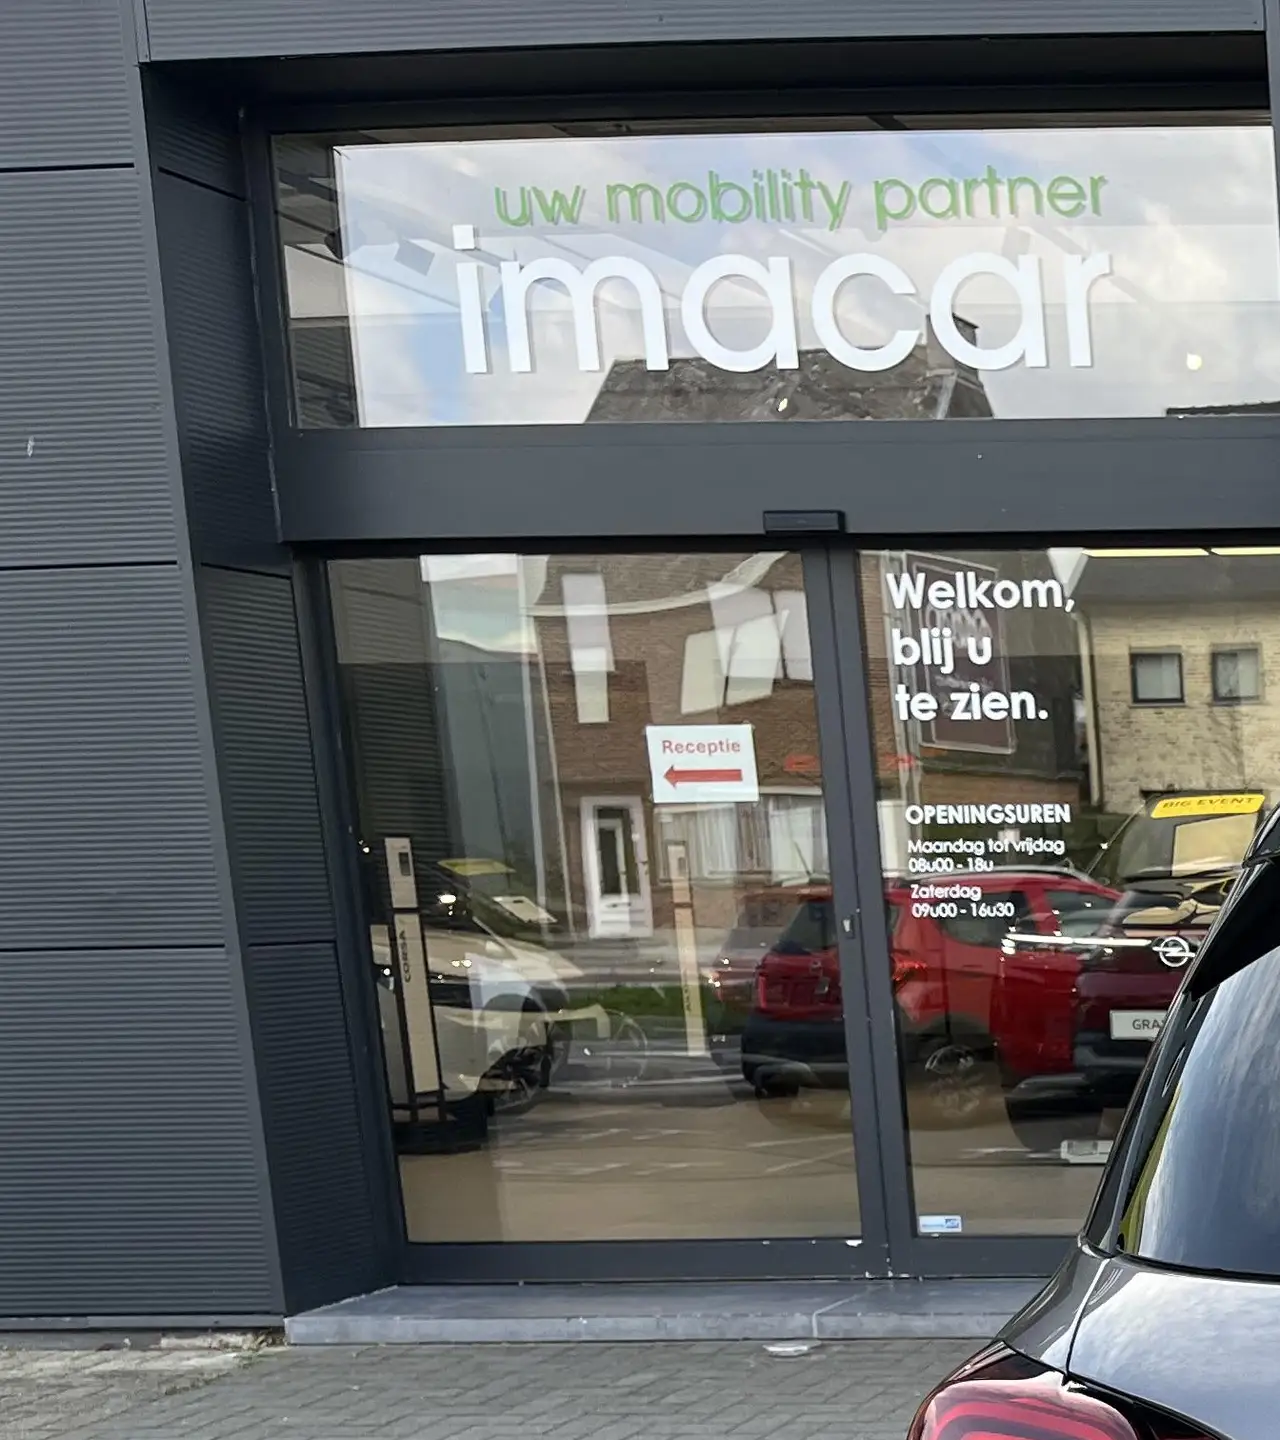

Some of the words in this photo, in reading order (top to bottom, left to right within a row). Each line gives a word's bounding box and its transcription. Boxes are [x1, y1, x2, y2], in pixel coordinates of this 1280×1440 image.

[494, 184, 586, 227] uw
[608, 168, 853, 231] mobility
[875, 165, 1108, 230] partner
[451, 224, 1114, 375] imacar
[886, 571, 1075, 613] Welkom,
[892, 627, 955, 674] blij
[966, 636, 993, 666] u
[895, 683, 939, 721] te
[950, 682, 1049, 721] zien.
[661, 739, 741, 756] Receptie
[1197, 798, 1256, 806] EVENT
[905, 803, 1071, 824] OPENINGSUREN
[907, 838, 985, 855] Maandag
[988, 838, 1010, 853] tot
[1011, 837, 1065, 855] vrijdag
[908, 857, 954, 872] 08u00
[967, 857, 994, 872] 18u
[910, 884, 982, 900] Zaterdag
[911, 903, 958, 918] 09u00
[971, 902, 1015, 917] 16u30
